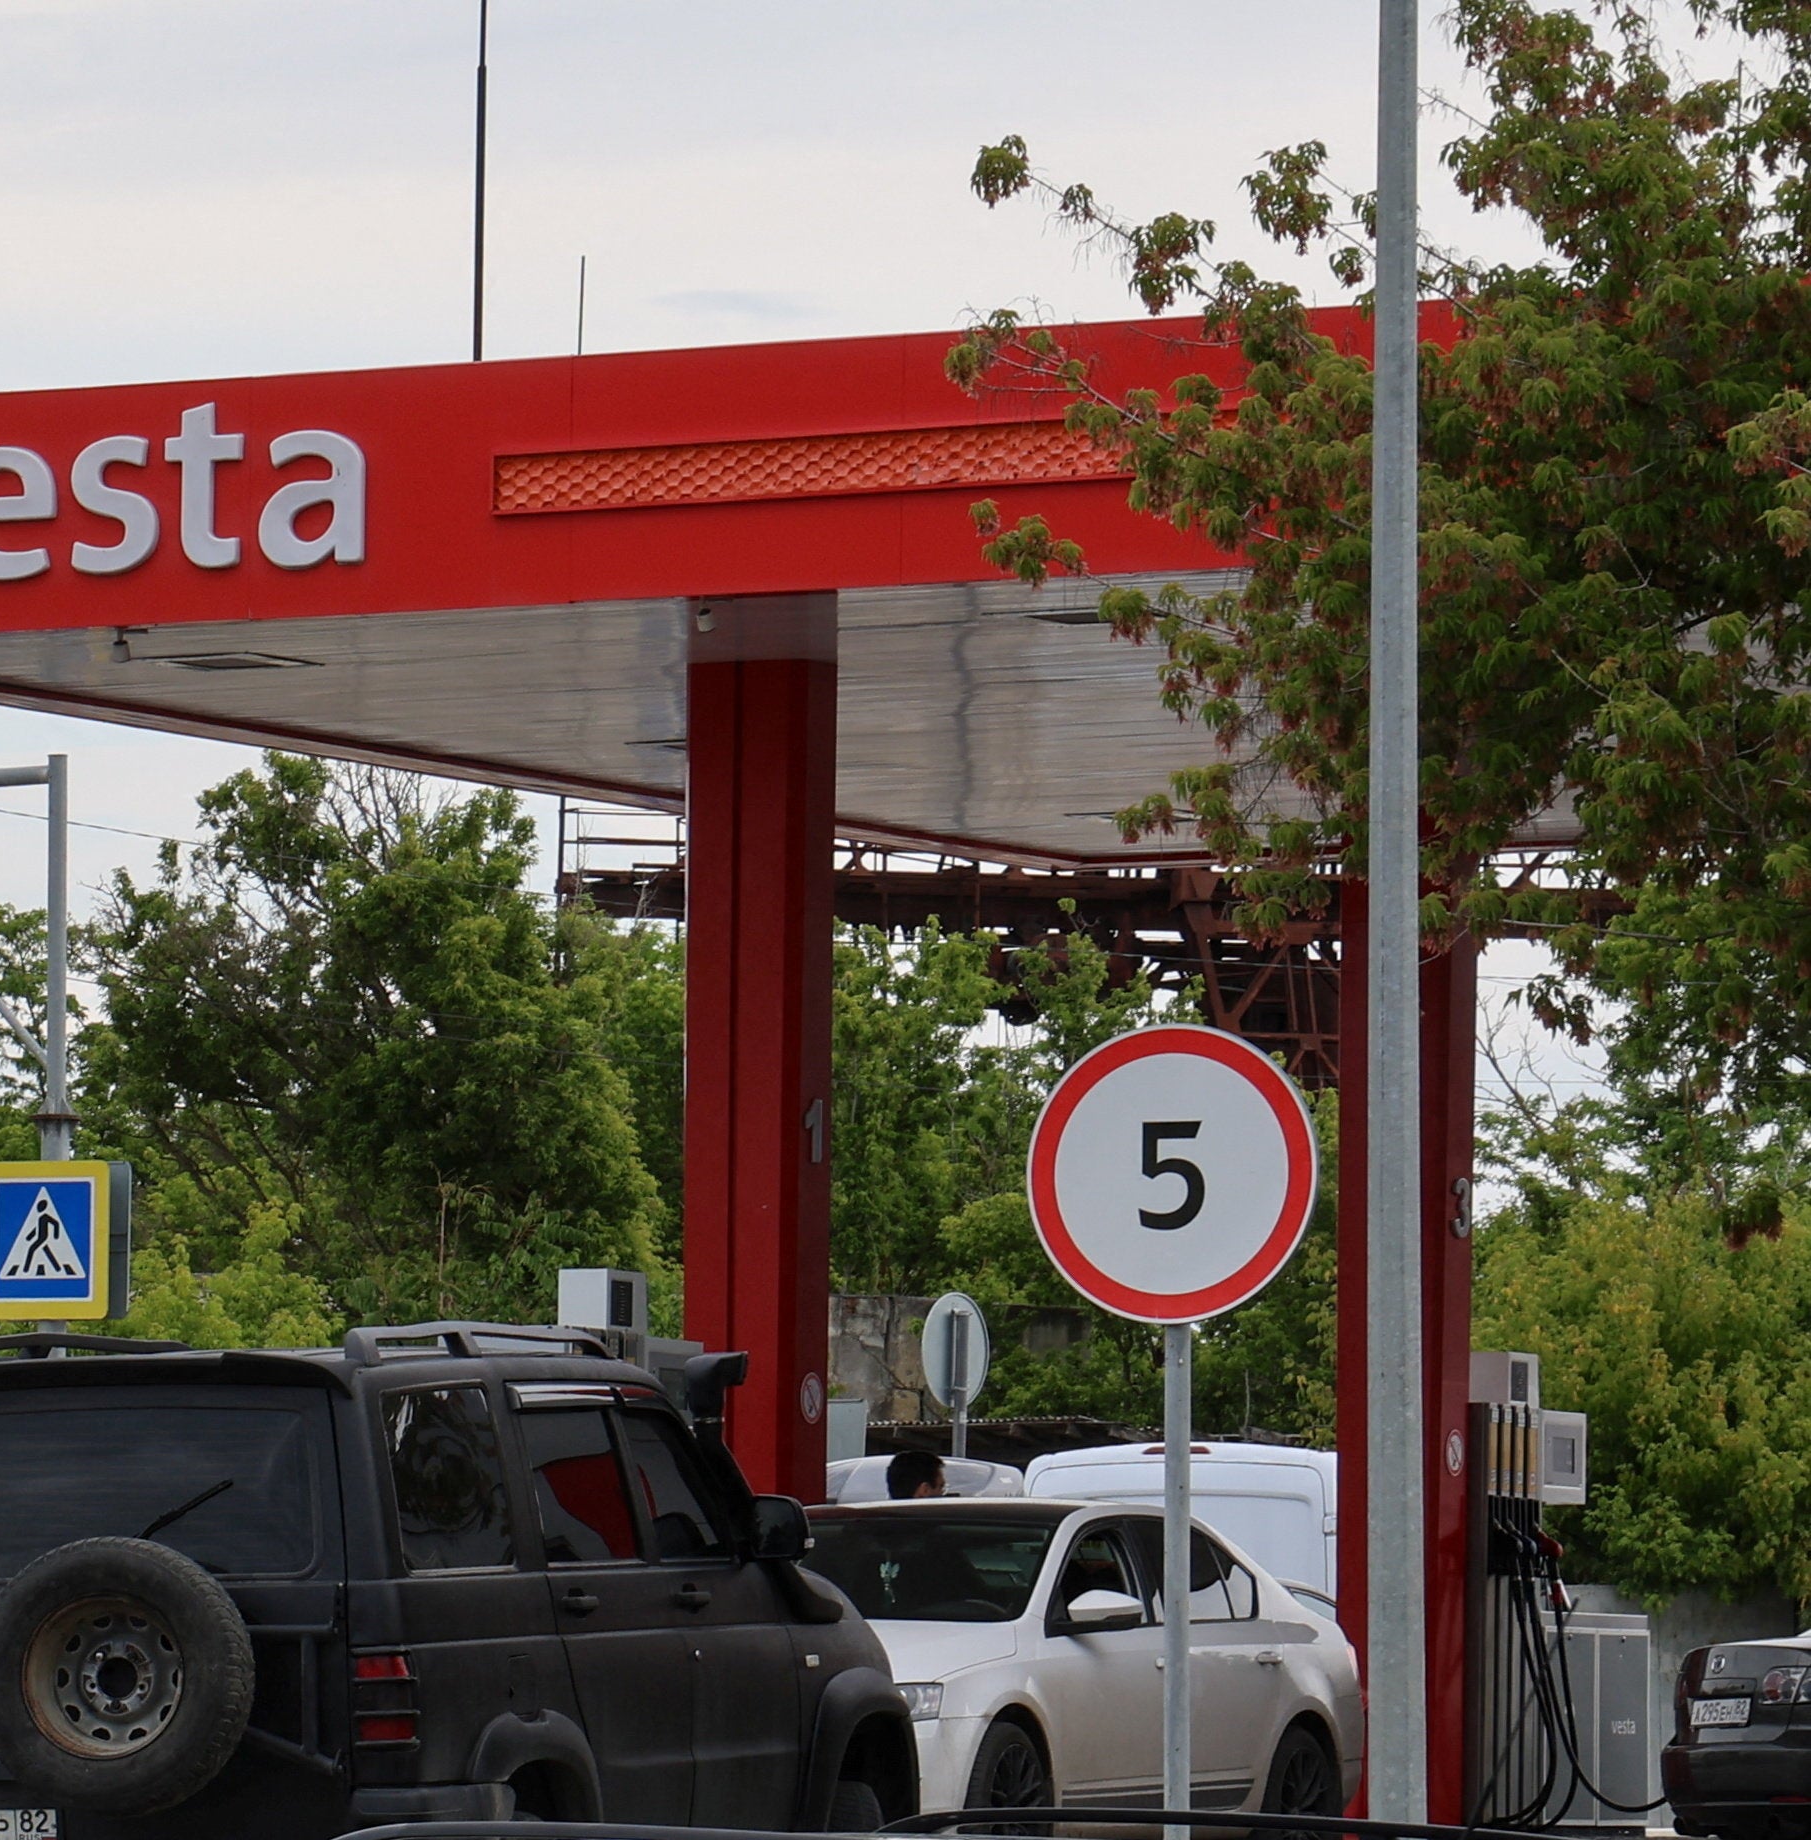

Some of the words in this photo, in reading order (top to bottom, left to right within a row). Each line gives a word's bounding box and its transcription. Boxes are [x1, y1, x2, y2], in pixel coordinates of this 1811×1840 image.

[804, 1098, 823, 1163] 1
[1138, 1120, 1205, 1230] 5
[1453, 1177, 1471, 1238] 3
[1611, 1718, 1636, 1734] vesta
[20, 1810, 48, 1833] 82
